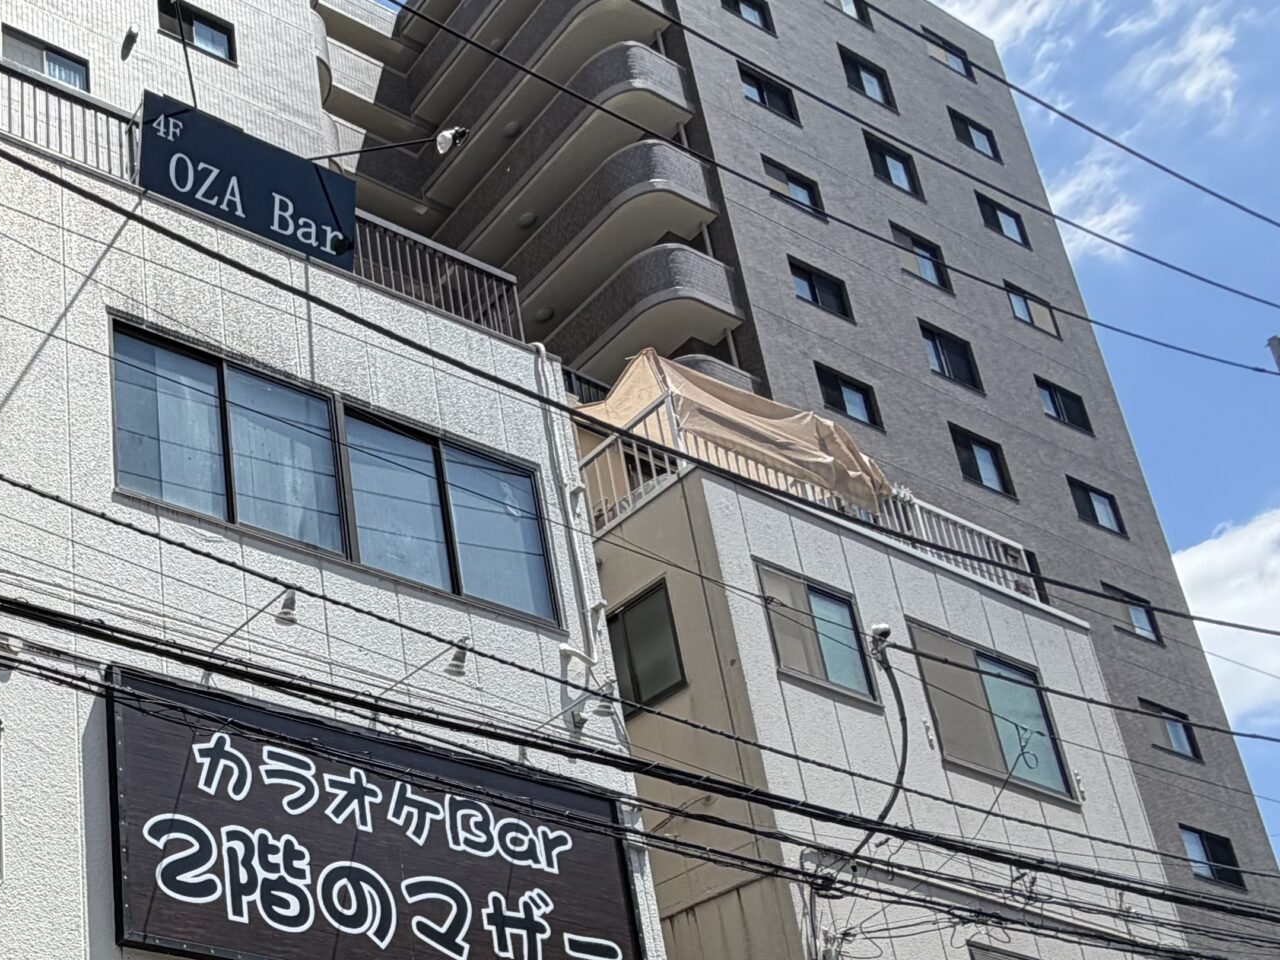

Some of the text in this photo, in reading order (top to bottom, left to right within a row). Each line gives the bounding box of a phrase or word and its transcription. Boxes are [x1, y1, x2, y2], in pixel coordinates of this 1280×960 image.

[152, 114, 183, 141] 4F
[169, 153, 345, 256] OZA Bar
[193, 732, 573, 874] カラオケBar
